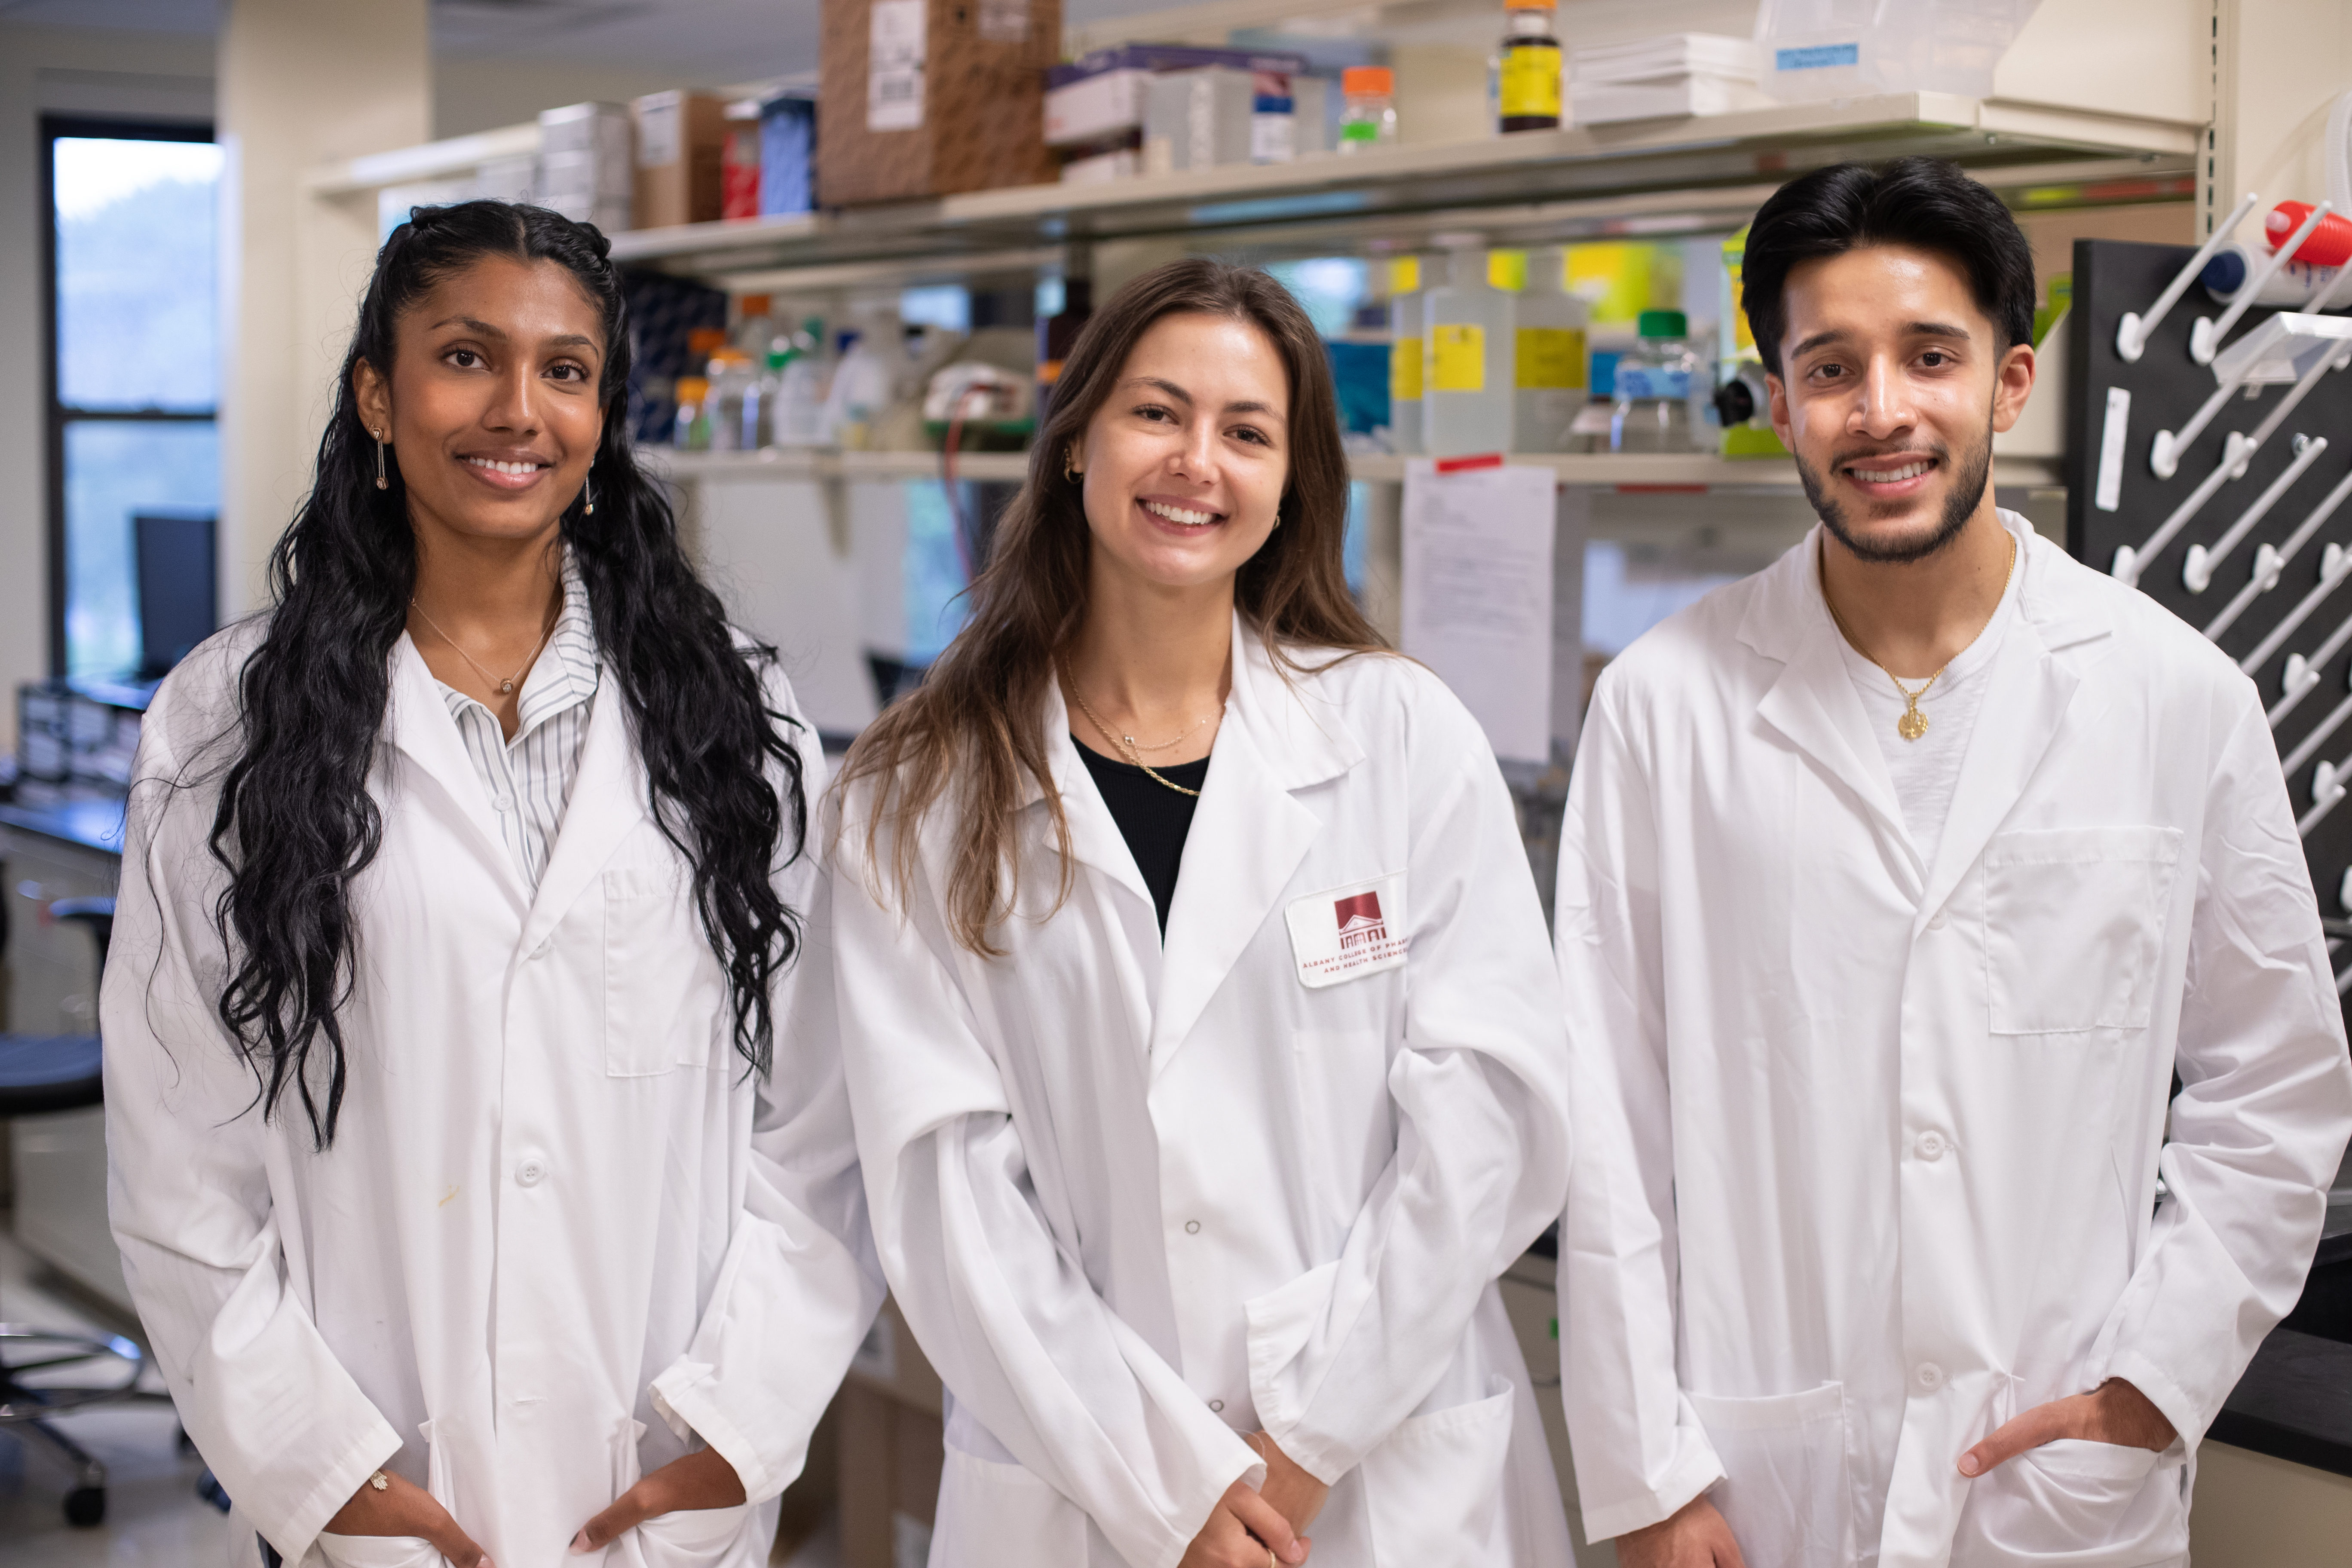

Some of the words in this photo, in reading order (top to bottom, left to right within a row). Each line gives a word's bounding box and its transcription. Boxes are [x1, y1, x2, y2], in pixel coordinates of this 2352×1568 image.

[1303, 957, 1334, 968] ALBANY
[1338, 949, 1366, 961] COLLEGE
[1344, 958, 1368, 968] HEALTH
